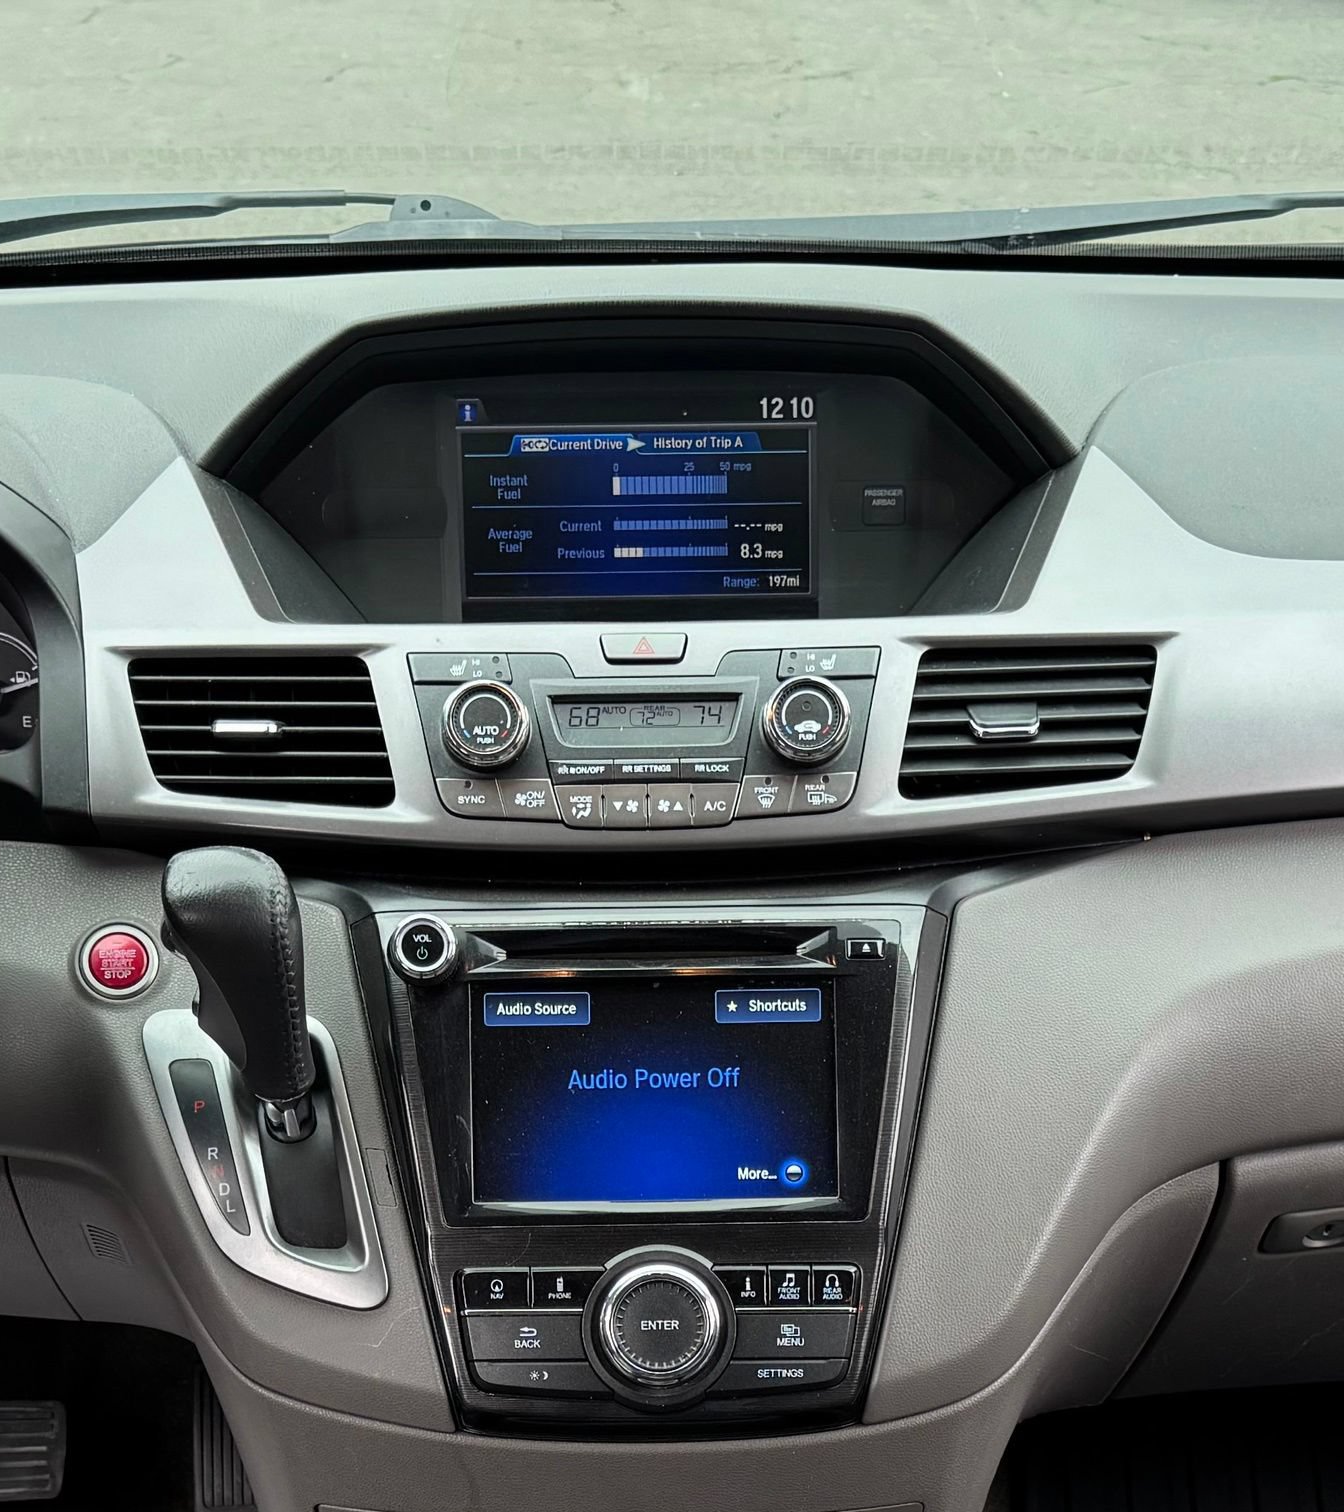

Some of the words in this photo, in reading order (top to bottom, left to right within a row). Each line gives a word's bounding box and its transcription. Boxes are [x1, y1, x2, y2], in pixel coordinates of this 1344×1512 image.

[550, 439, 592, 450] Current
[594, 438, 623, 450] Drive
[653, 436, 692, 451] History
[696, 436, 708, 448] of
[710, 436, 730, 450] Trip
[732, 436, 744, 448] A
[613, 464, 619, 472] 0
[684, 462, 695, 472] 25
[719, 462, 731, 472] 50
[733, 463, 752, 472] mpg
[488, 474, 529, 487] Instant
[497, 488, 522, 500] Fuel
[559, 520, 602, 532] Current
[764, 522, 784, 533] mpg
[488, 527, 533, 541] Average
[498, 541, 523, 554] Fuel
[557, 547, 606, 560] Previous
[740, 542, 762, 559] 8.3
[764, 549, 784, 560] mpg
[722, 576, 760, 588] Range:
[768, 574, 800, 588] 197mi
[472, 670, 482, 678] LO
[568, 706, 600, 728] 68
[602, 706, 627, 715] AUTO
[637, 712, 656, 726] 72
[656, 710, 674, 718] AUTO
[693, 705, 722, 725] 74
[22, 716, 32, 728] E
[472, 726, 500, 736] AUTO
[798, 732, 816, 740] PUSH
[476, 736, 495, 744] PUSH
[634, 764, 672, 773] SETTINGS
[706, 764, 730, 772] LOCK
[754, 786, 778, 794] FRONT
[804, 784, 826, 792] REAR
[457, 795, 486, 804] SYNC
[526, 790, 546, 800] ON/
[570, 795, 593, 804] MODE
[526, 799, 546, 808] OFF
[704, 800, 727, 812] A/C
[412, 934, 433, 944] VOL
[98, 949, 136, 958] ENGINE
[101, 958, 134, 968] START
[104, 970, 132, 979] STOP
[496, 1002, 530, 1016] Audio
[534, 1001, 577, 1016] Source
[748, 998, 807, 1014] Shortcuts
[568, 1070, 628, 1090] Audio
[634, 1068, 700, 1088] Power
[707, 1067, 741, 1088] Off
[194, 1100, 205, 1112] P
[208, 1147, 218, 1160] R
[218, 1182, 230, 1196] D
[226, 1200, 236, 1213] L
[740, 1290, 756, 1298] INFO
[777, 1286, 801, 1294] FRONT
[823, 1286, 842, 1294] REAR
[490, 1292, 504, 1300] NAV
[548, 1292, 572, 1300] PHONE
[640, 1320, 680, 1331] ENTER
[514, 1338, 541, 1349] BACK
[776, 1336, 805, 1347] MENU
[756, 1368, 804, 1379] SETTINGS
